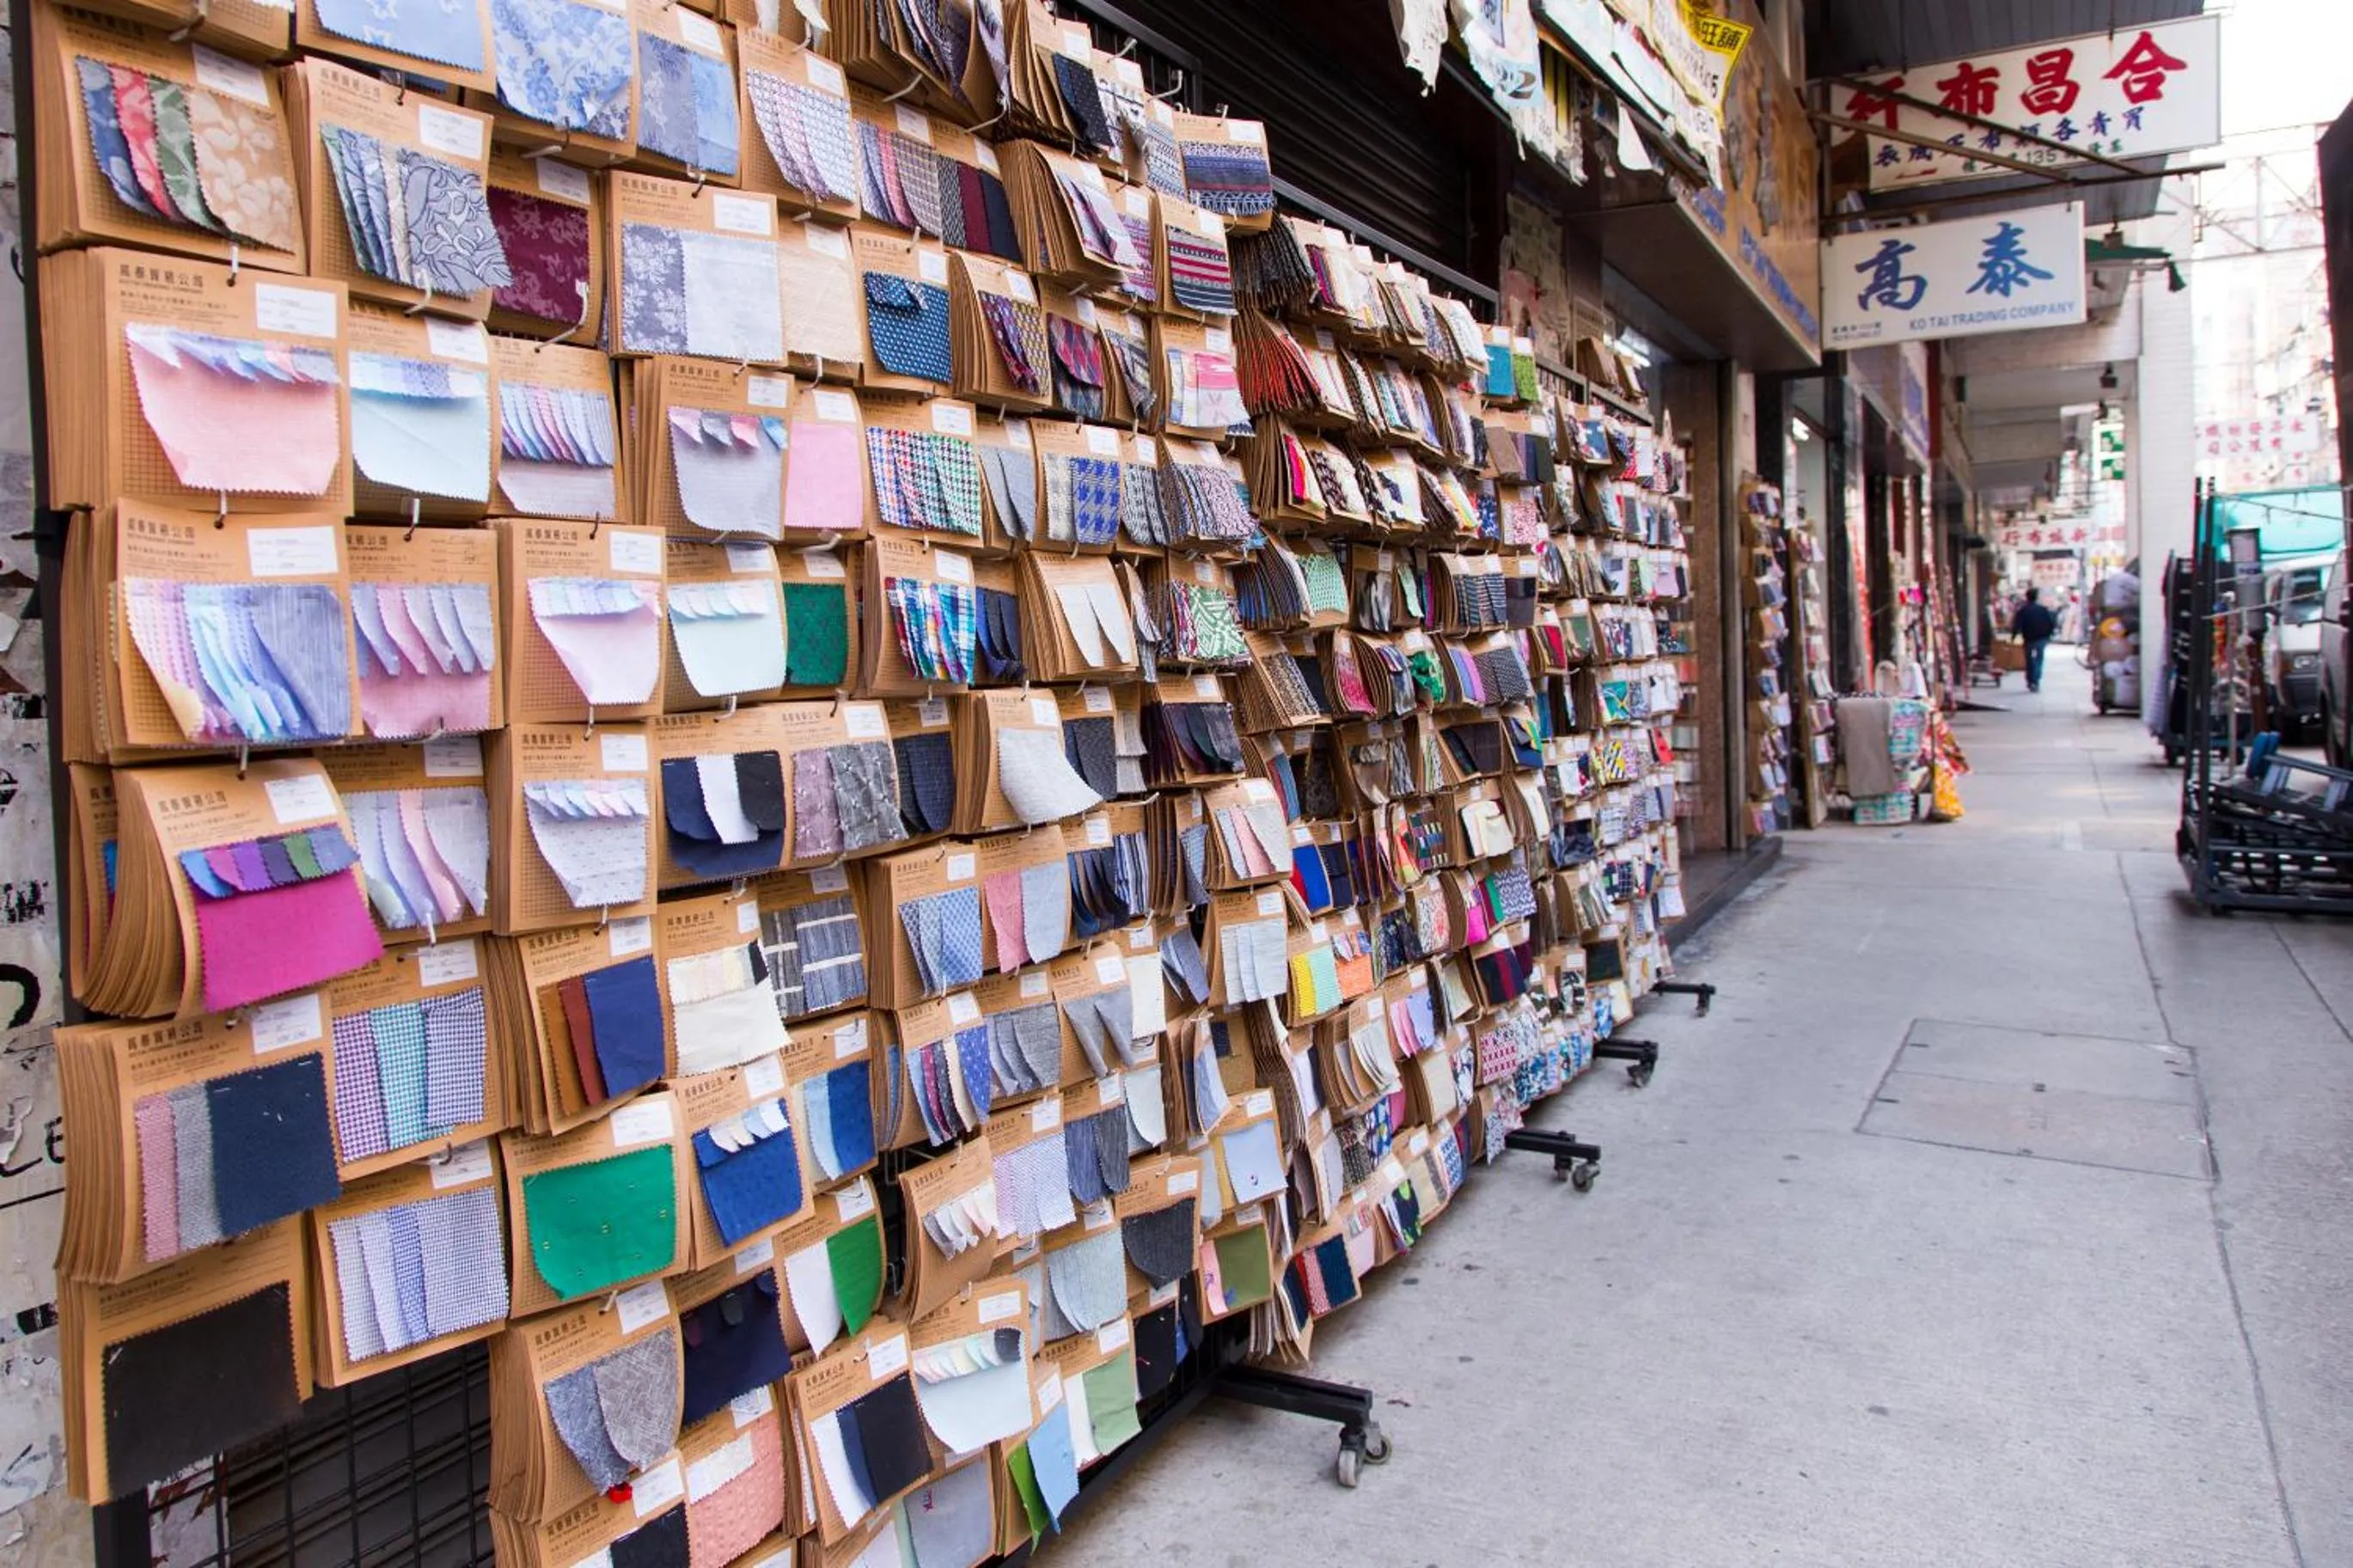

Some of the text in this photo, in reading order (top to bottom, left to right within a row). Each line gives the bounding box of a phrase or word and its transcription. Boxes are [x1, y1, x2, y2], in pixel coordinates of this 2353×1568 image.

[1855, 221, 2055, 312] 高泰
[1909, 302, 2076, 332] KO TAI TRADING COMPANY
